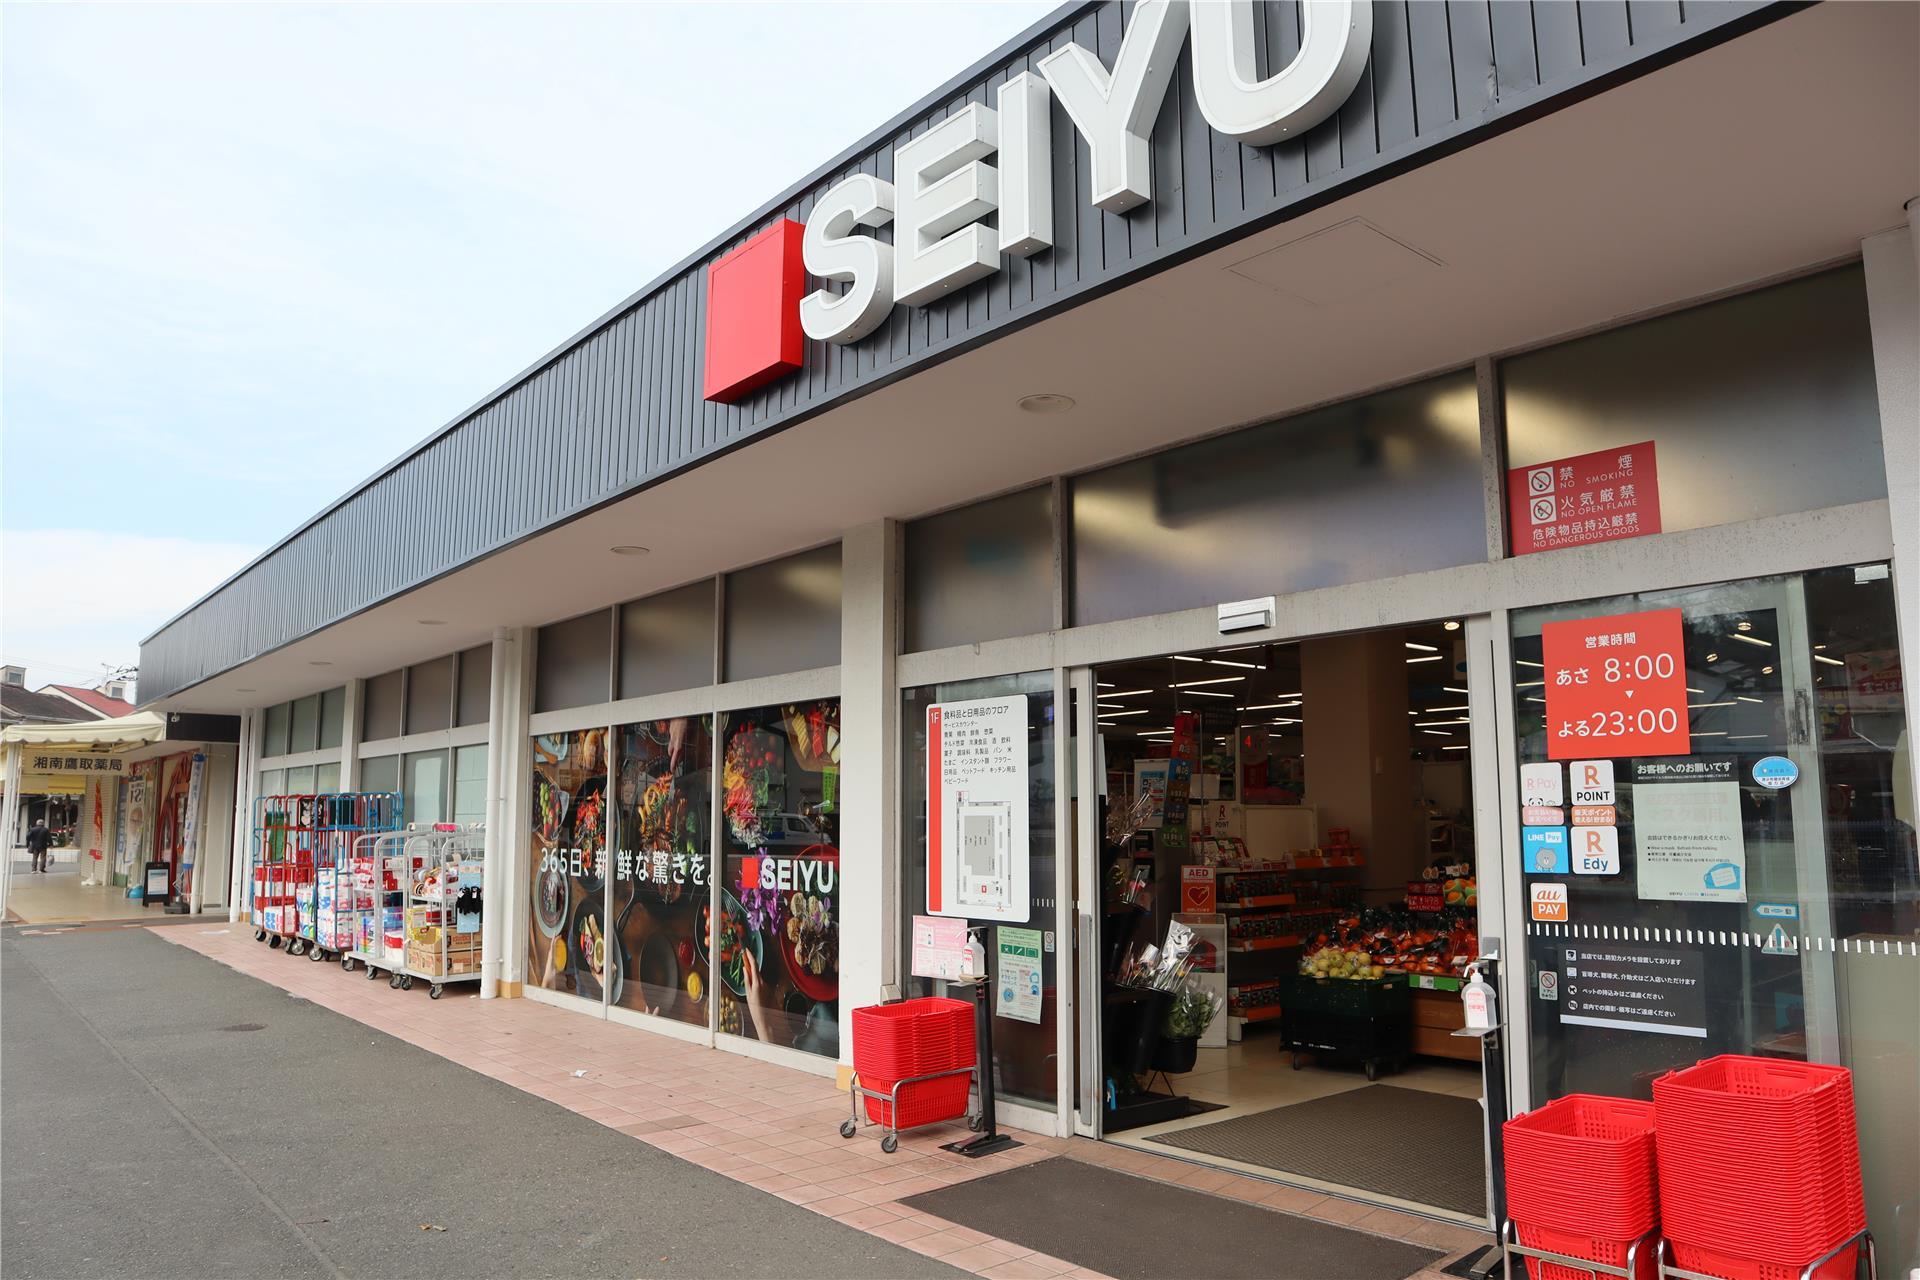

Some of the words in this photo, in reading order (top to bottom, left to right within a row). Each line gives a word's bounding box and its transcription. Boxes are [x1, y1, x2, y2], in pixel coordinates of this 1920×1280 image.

[800, 0, 1374, 345] SEIYU
[1560, 480, 1576, 489] NO
[1586, 469, 1634, 485] SMOKING
[1561, 484, 1636, 511] 火気厳禁
[1561, 510, 1576, 518] NO
[1578, 505, 1604, 516] OPEN
[1606, 498, 1638, 510] FLAME
[1532, 512, 1639, 541] 危険物品持込厳禁
[1533, 540, 1548, 549] NO
[1549, 531, 1605, 546] DANGEROUS
[1606, 524, 1640, 537] GOODS
[1585, 631, 1637, 649] 営業時間
[1556, 667, 1590, 686] あさ
[1604, 653, 1675, 683] 8:00
[930, 712, 939, 724] 1F
[944, 705, 1009, 720] 食料品と日用品のフロア
[33, 755, 123, 771] 湘南鷹取薬局
[1637, 761, 1732, 775] お客様へのお願いです
[944, 768, 958, 776] 日用品
[961, 767, 985, 775] ペットフード
[989, 766, 1017, 774] キッチン用品
[1537, 778, 1558, 790] Pay
[1576, 791, 1611, 802] POINT
[1527, 833, 1544, 841] LINE
[1584, 857, 1608, 872] Edy
[761, 858, 834, 894] SEIYU
[1189, 869, 1209, 877] AED
[1537, 889, 1561, 901] au
[1538, 904, 1561, 915] PAY
